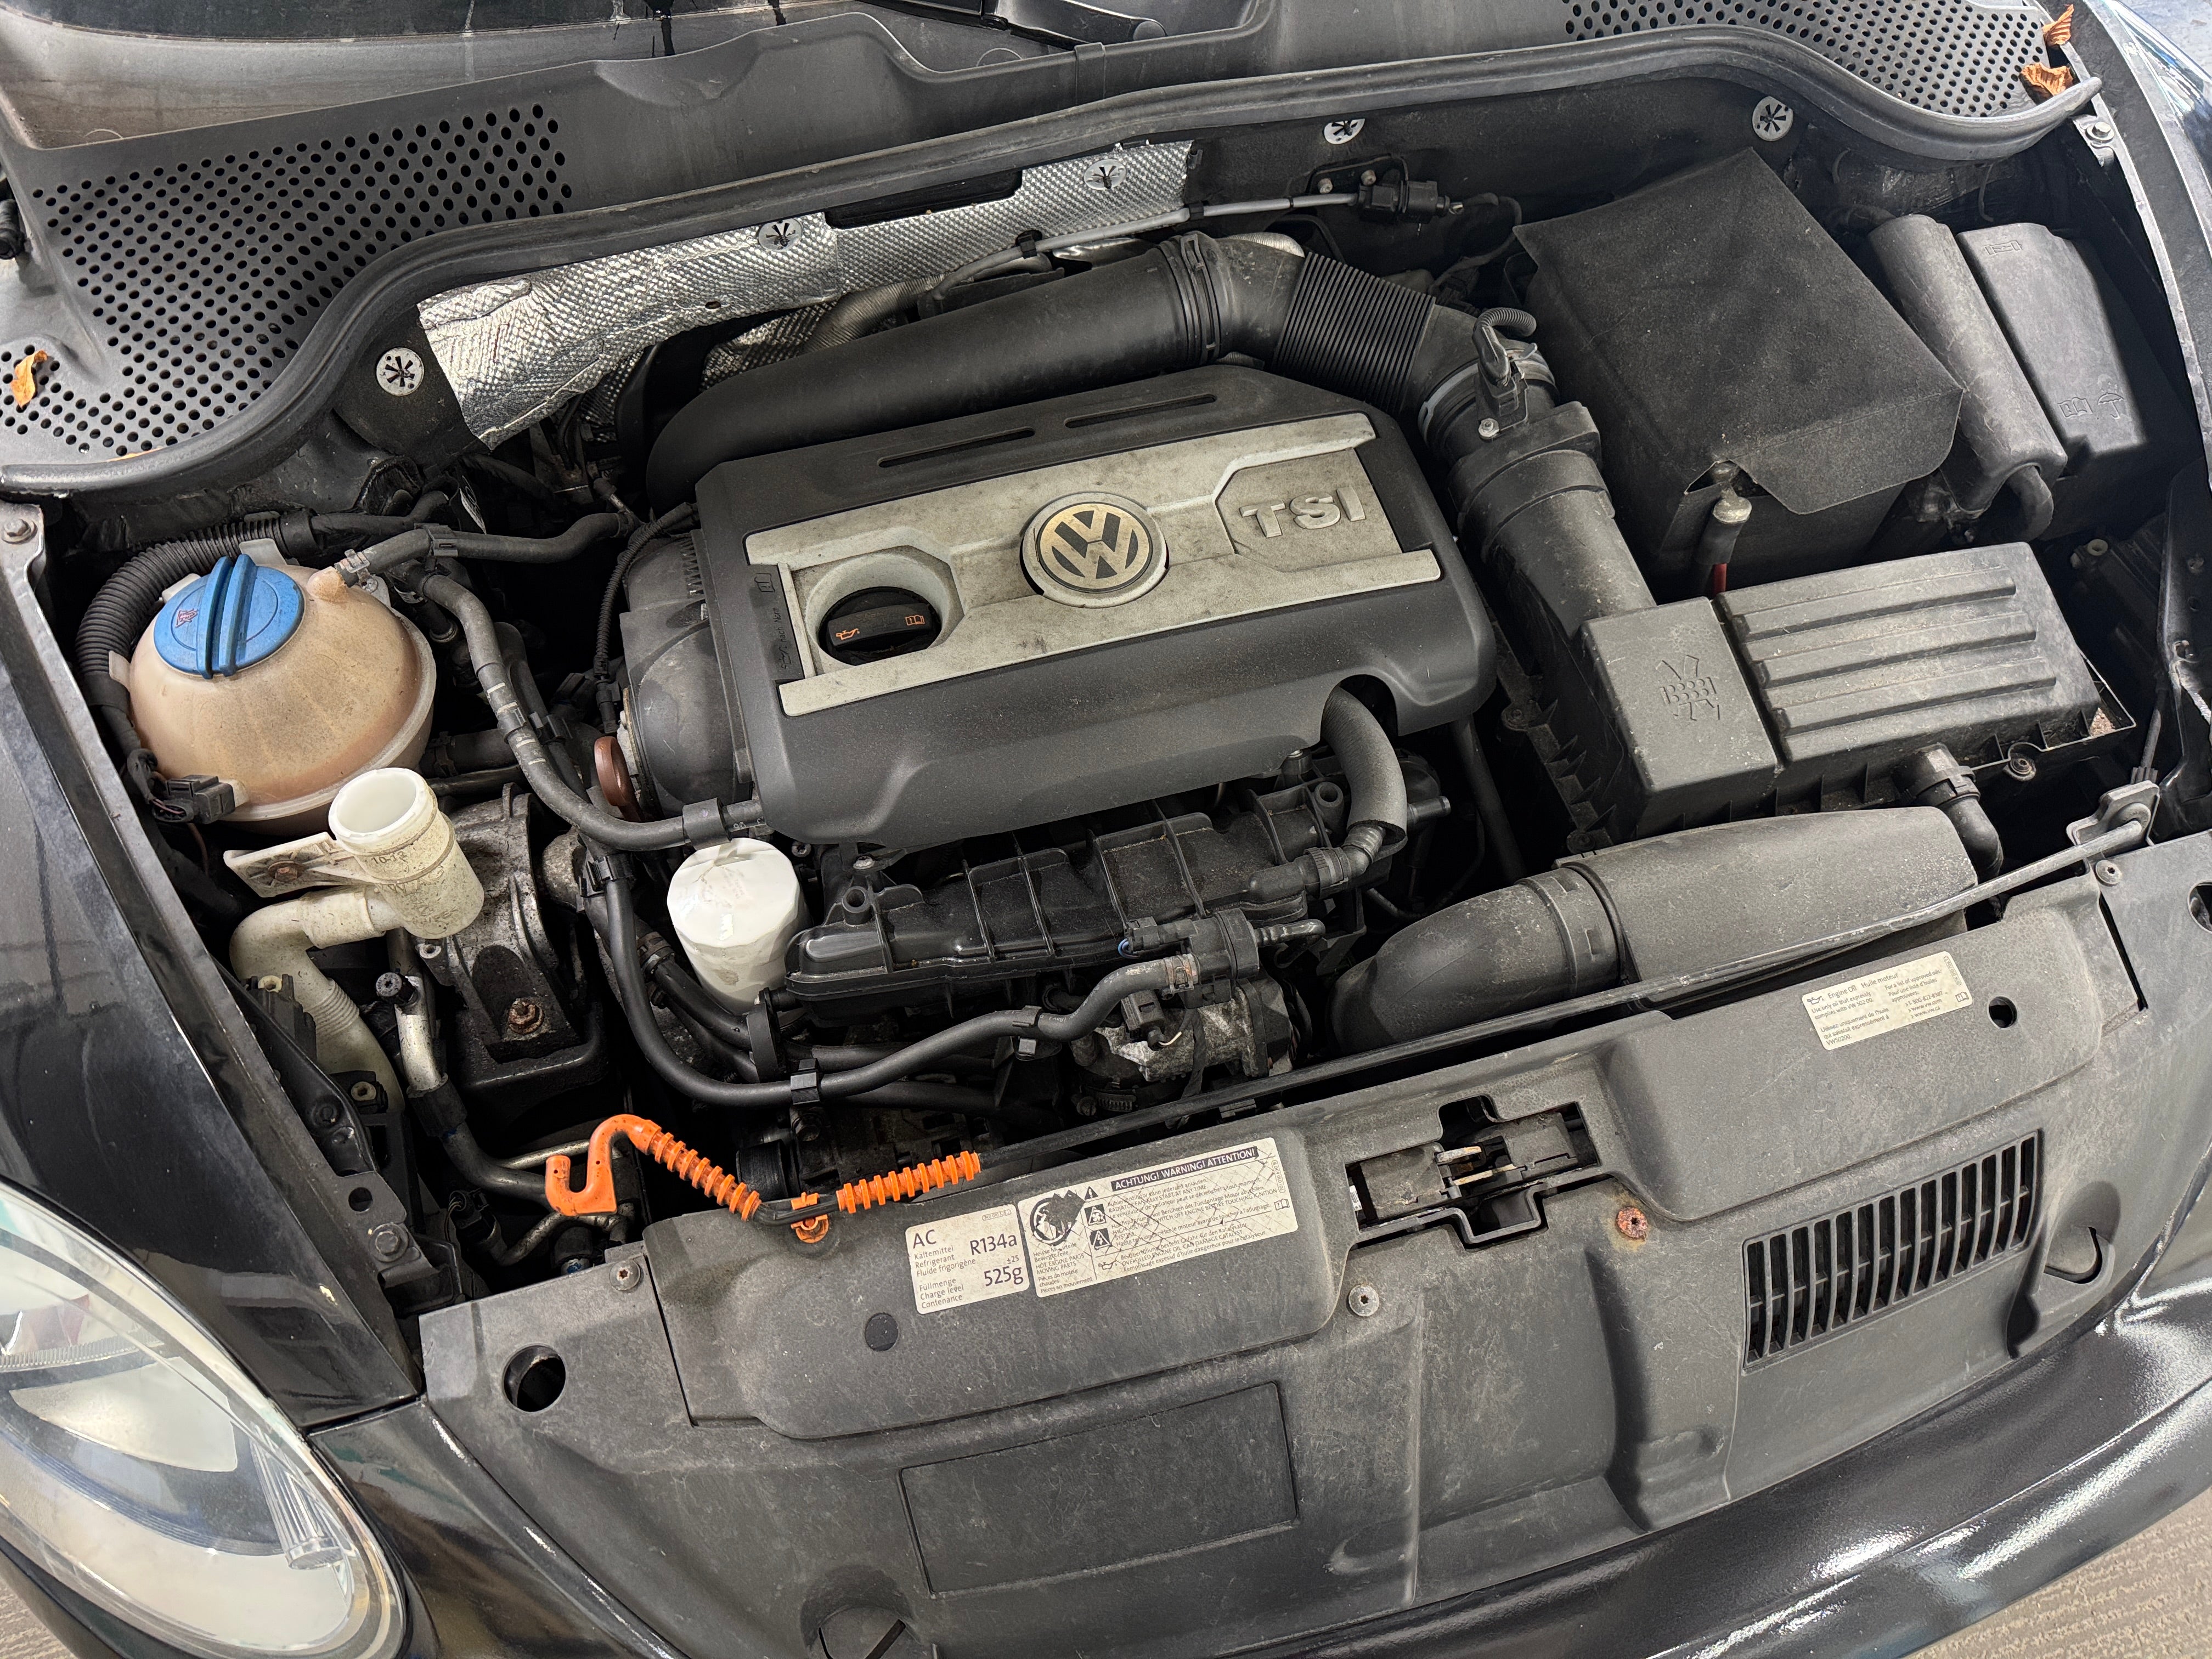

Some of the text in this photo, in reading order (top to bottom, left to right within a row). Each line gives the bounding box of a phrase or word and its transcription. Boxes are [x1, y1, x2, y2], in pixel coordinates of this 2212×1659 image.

[1239, 487, 1366, 538] TSI
[1039, 503, 1150, 590] VW
[773, 607, 787, 642] nach Norm
[1910, 972, 1932, 983] approved
[1828, 988, 1848, 1000] Engine
[1861, 979, 1877, 988] Huile
[1877, 973, 1898, 983] moteur
[1849, 991, 1871, 1002] expressly
[1815, 1009, 1836, 1020] complies
[1839, 1013, 1867, 1027] uniquement
[1115, 1148, 1255, 1190] ACHTUNG! WARNING! ATTENTION!
[1184, 1206, 1204, 1215] ENGINE
[1225, 1194, 1253, 1205] TOUCHING
[1254, 1188, 1277, 1198] IGNITION
[1178, 1222, 1196, 1230] moteur
[913, 1229, 937, 1249] AC
[970, 1233, 1018, 1255] R134a
[916, 1255, 955, 1268] Refrigerant
[1007, 1255, 1019, 1264] ±25
[1048, 1257, 1068, 1266] ENGINE
[917, 1258, 976, 1277] Fluide frigorigène
[1037, 1266, 1059, 1274] MOVING
[984, 1266, 1024, 1286] 525g
[1064, 1277, 1093, 1288] mouvement
[919, 1278, 956, 1291] Füllmenge
[920, 1284, 964, 1300] Charge level
[922, 1294, 962, 1308] Contenance
